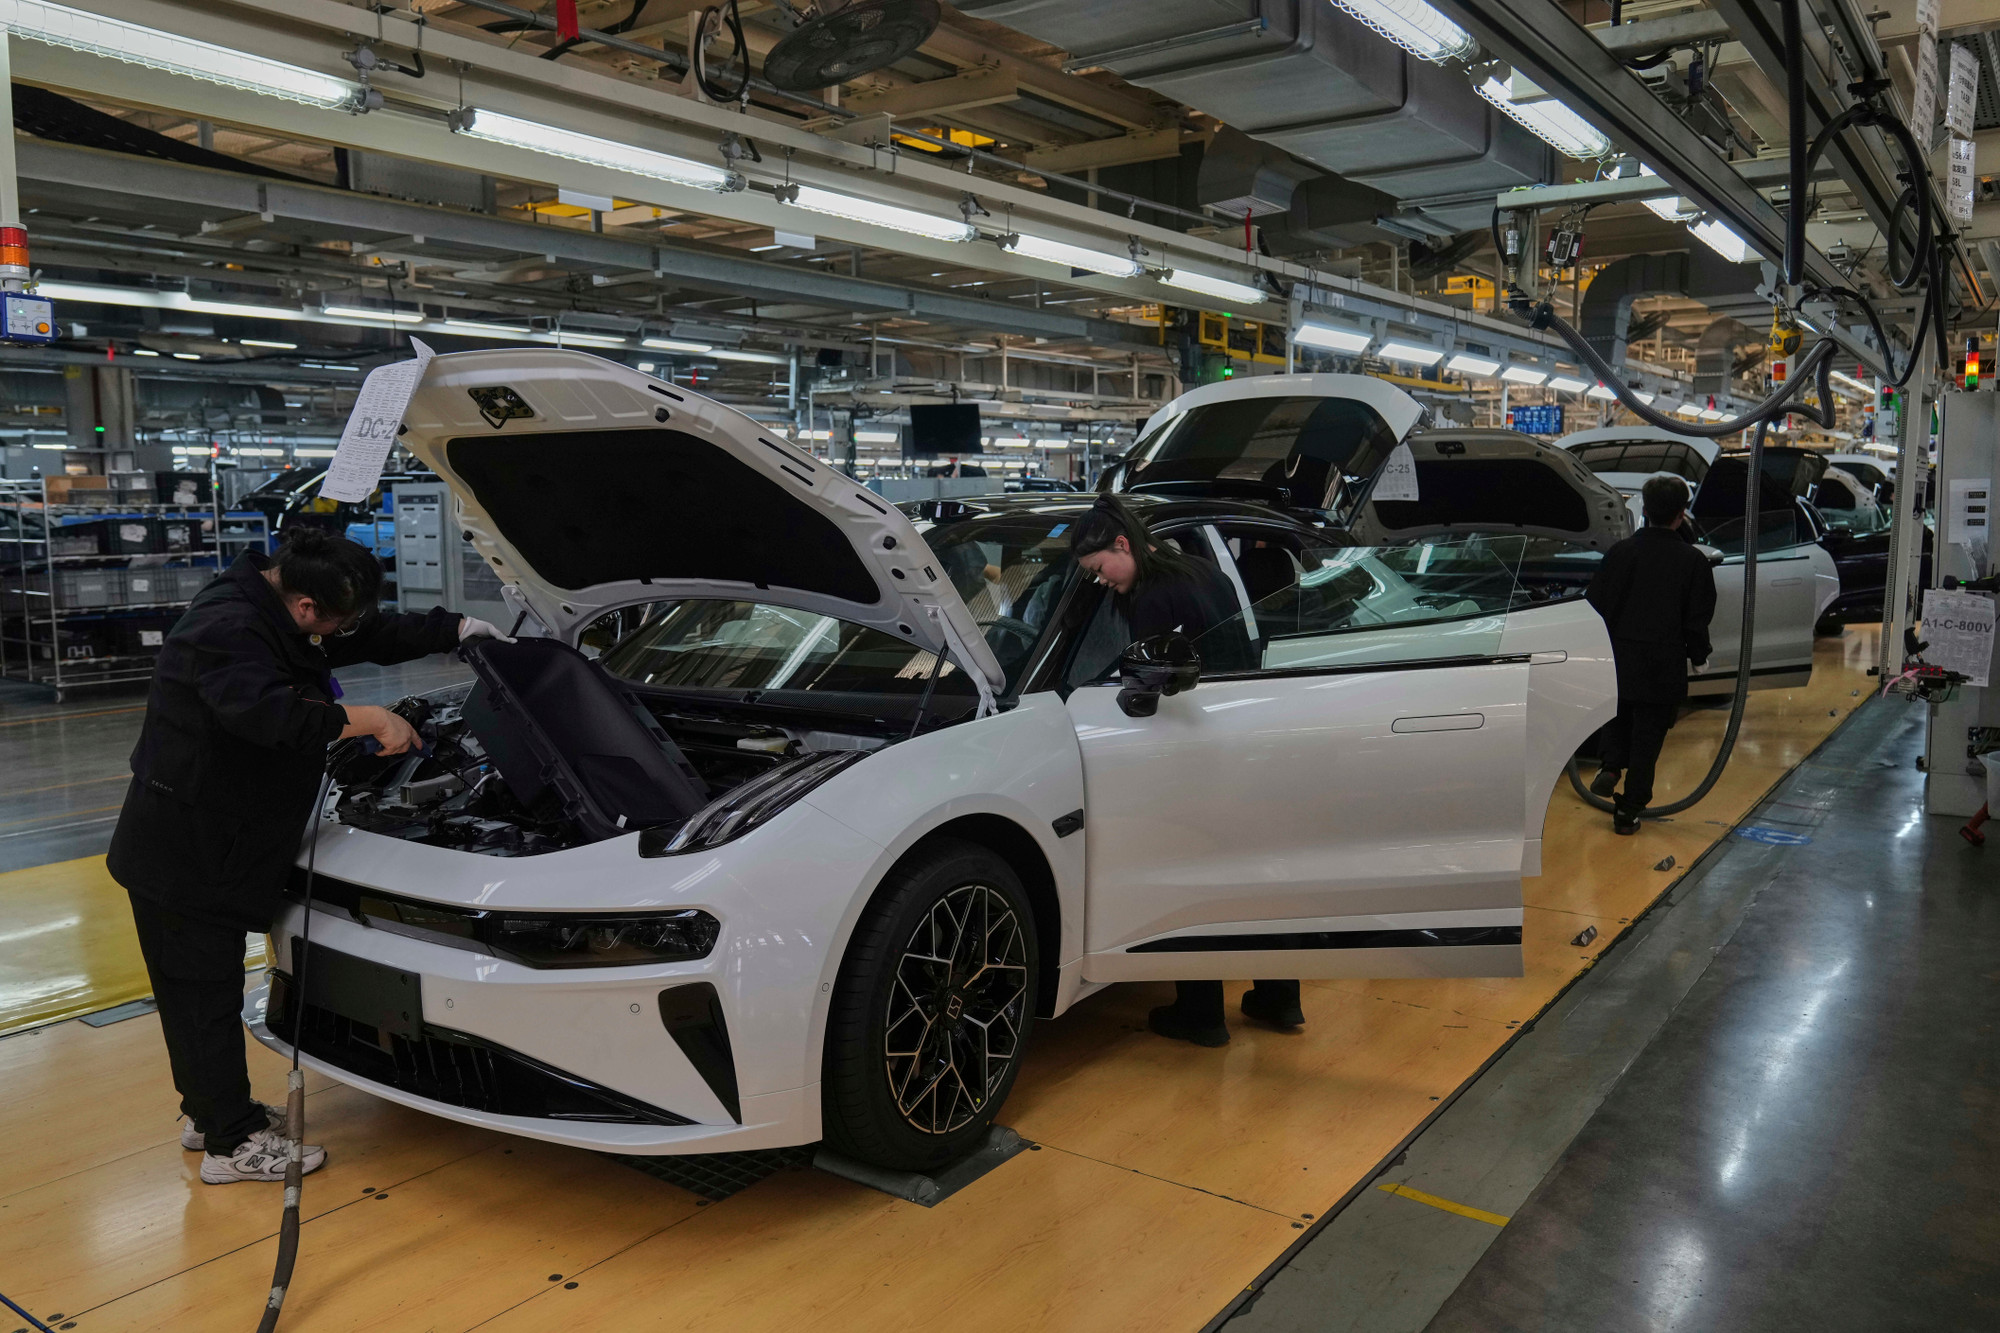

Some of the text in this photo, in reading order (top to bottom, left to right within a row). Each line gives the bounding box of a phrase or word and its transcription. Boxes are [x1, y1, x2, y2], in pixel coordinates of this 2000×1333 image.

[1384, 464, 1410, 474] C-25
[1921, 618, 1993, 633] A1-C-800V
[245, 1155, 265, 1168] N
